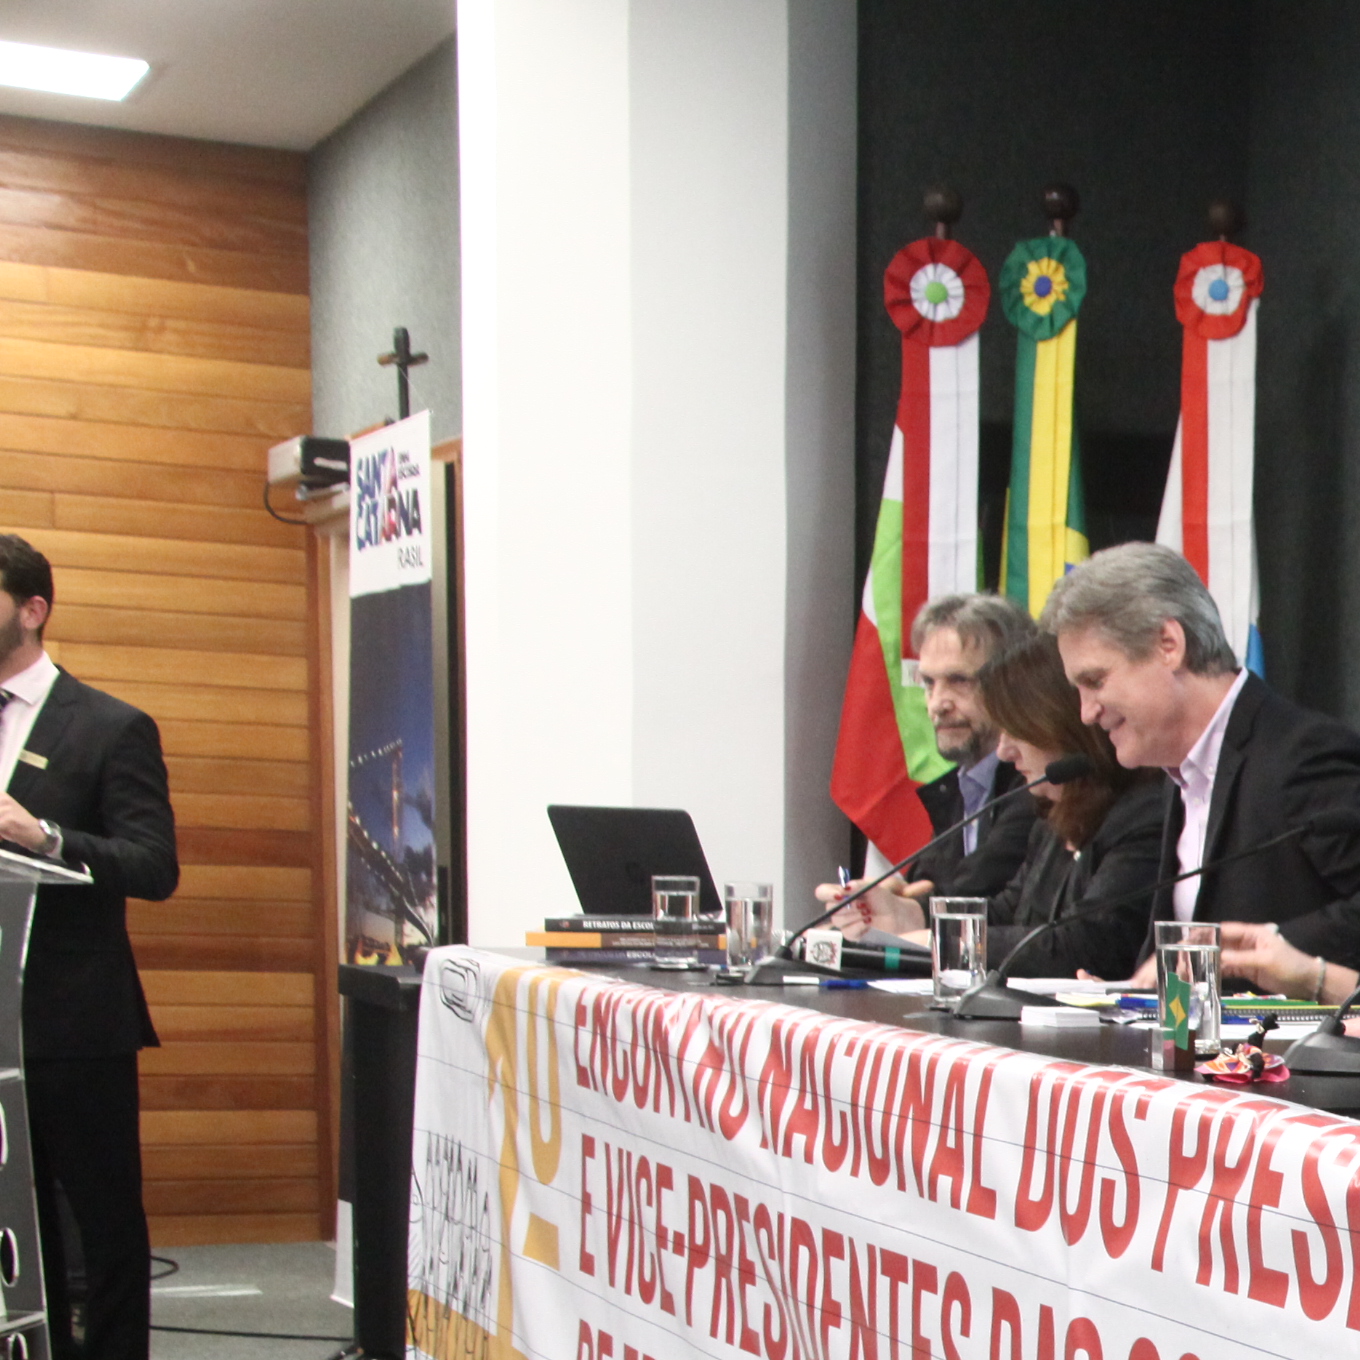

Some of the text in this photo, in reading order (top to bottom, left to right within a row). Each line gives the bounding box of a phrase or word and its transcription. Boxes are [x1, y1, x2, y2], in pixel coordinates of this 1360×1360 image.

[578, 1133, 596, 1277] E
[758, 1006, 1004, 1220] NACIONAL
[1014, 1062, 1168, 1260] DOS
